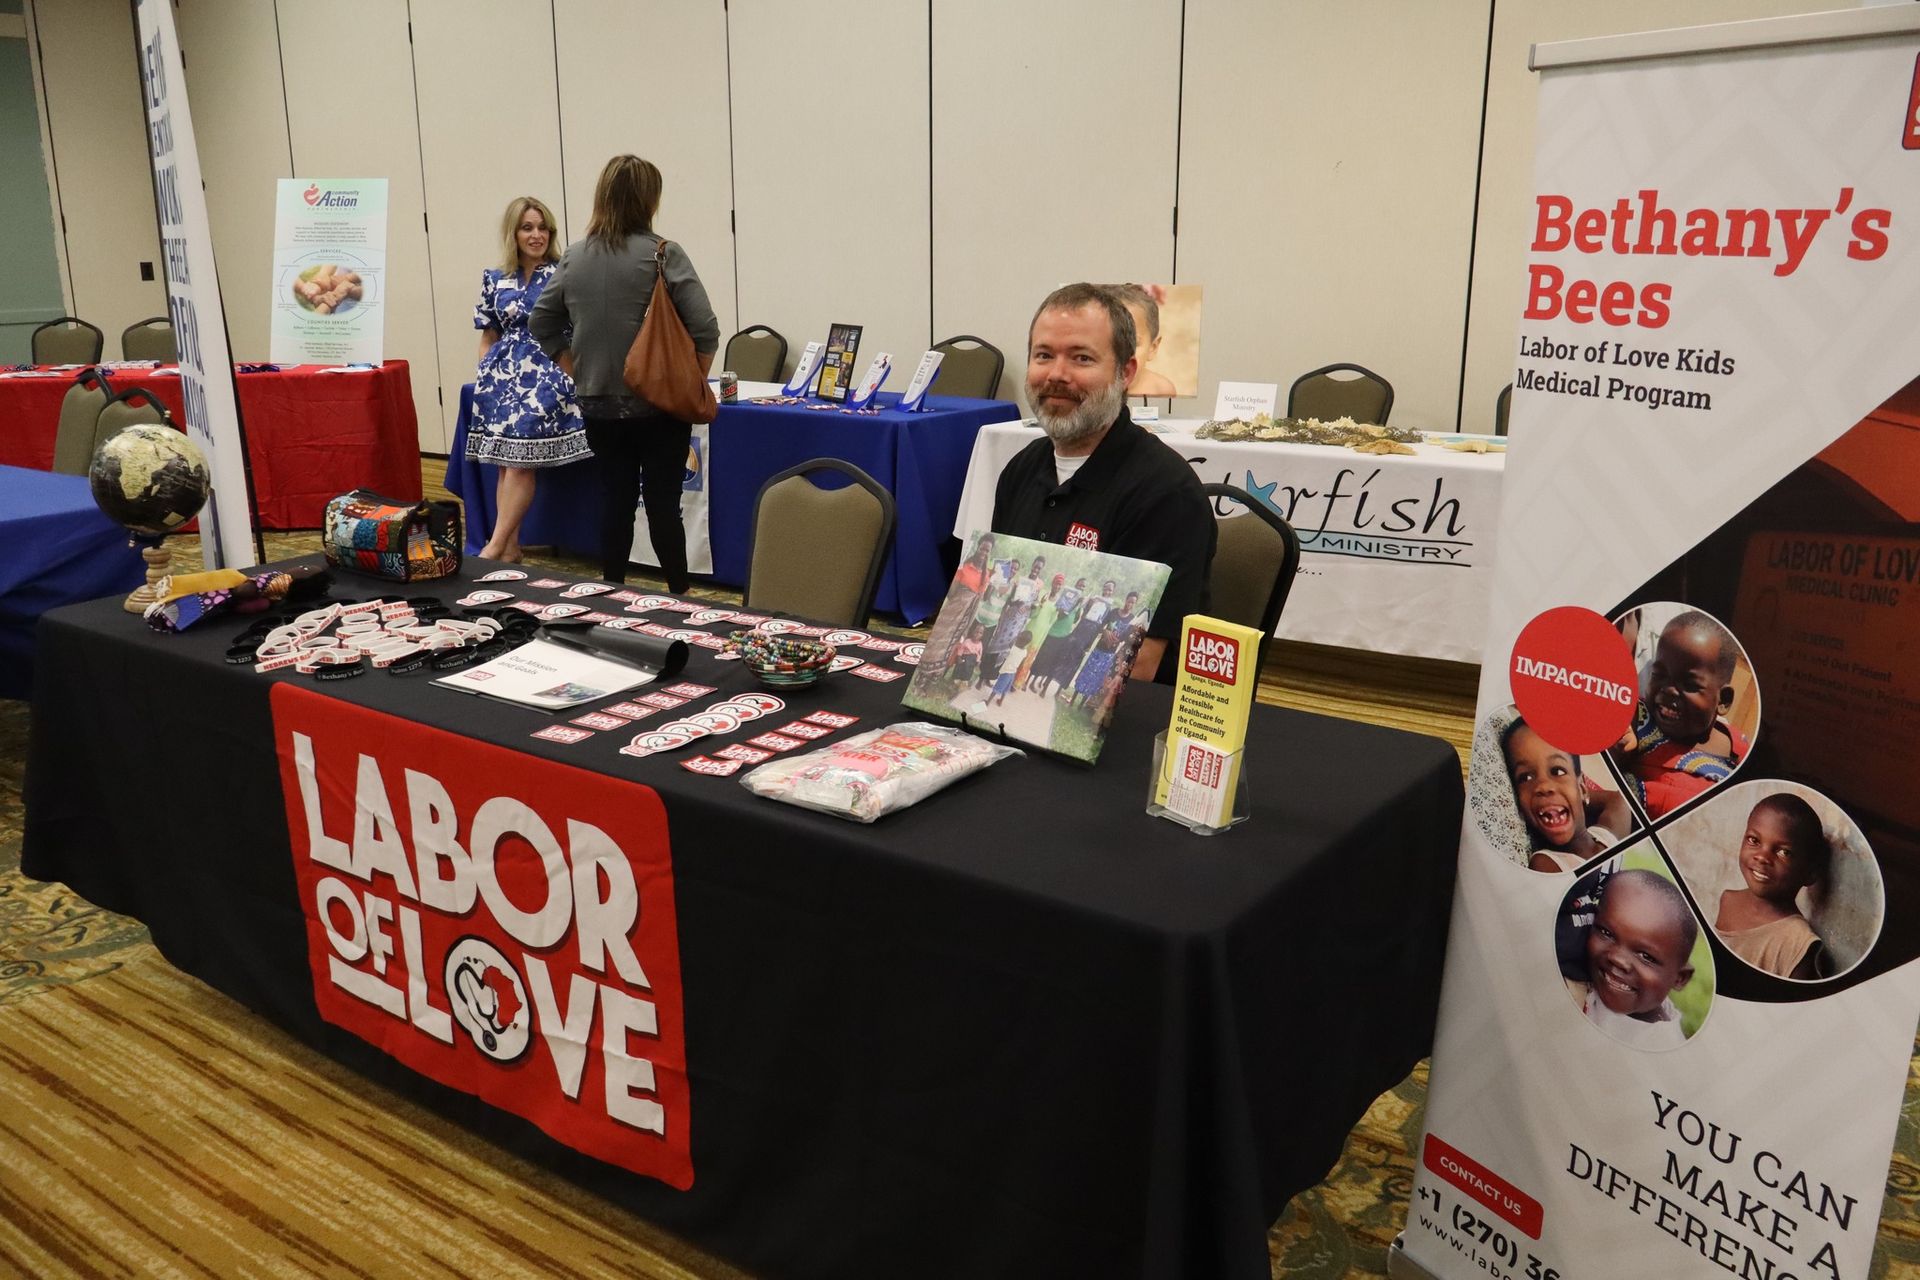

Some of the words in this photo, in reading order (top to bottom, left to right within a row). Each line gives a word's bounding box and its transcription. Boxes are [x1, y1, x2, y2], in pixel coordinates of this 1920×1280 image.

[316, 190, 358, 207] Action
[1531, 187, 1892, 277] Bethany's
[1523, 264, 1672, 328] Bees
[1520, 335, 1579, 361] Labor
[1584, 341, 1609, 364] of
[1612, 343, 1670, 370] Love
[1674, 348, 1736, 376] Kids
[1516, 368, 1601, 397] Medical
[1605, 377, 1713, 410] Program
[1070, 525, 1098, 544] LABOR
[1321, 536, 1463, 560] MINISTRY
[1767, 540, 1836, 574] LABOR
[1839, 544, 1868, 576] OF
[1872, 547, 1920, 585] LOV
[1785, 575, 1845, 599] MEDICAL
[1849, 582, 1900, 607] CLINIC
[526, 660, 559, 673] Mission
[1189, 652, 1202, 667] OF
[1201, 654, 1235, 680] LOVE
[1190, 634, 1236, 663] LABOR
[1182, 684, 1216, 701] Affordable
[1216, 694, 1230, 705] and
[1515, 655, 1632, 705] IMPACTING
[1179, 704, 1214, 722] Healthcare
[1214, 713, 1225, 725] for
[1180, 694, 1214, 711] Accessible
[1175, 726, 1184, 735] of
[1183, 727, 1208, 742] Uganda
[1177, 715, 1189, 726] the
[1188, 719, 1226, 739] Community
[292, 731, 652, 989] LABOR
[316, 876, 394, 976] OF
[400, 904, 664, 1136] LOVE
[1650, 1090, 1742, 1164] YOU
[1753, 1150, 1858, 1231] CAN
[1440, 1156, 1501, 1201] CONTACT
[1503, 1196, 1522, 1216] US
[1417, 1186, 1441, 1213] +1
[1452, 1204, 1518, 1268] (270)
[1566, 1143, 1800, 1280] DIFFEREN
[1662, 1149, 1798, 1255] MAKE
[1807, 1242, 1845, 1280] A
